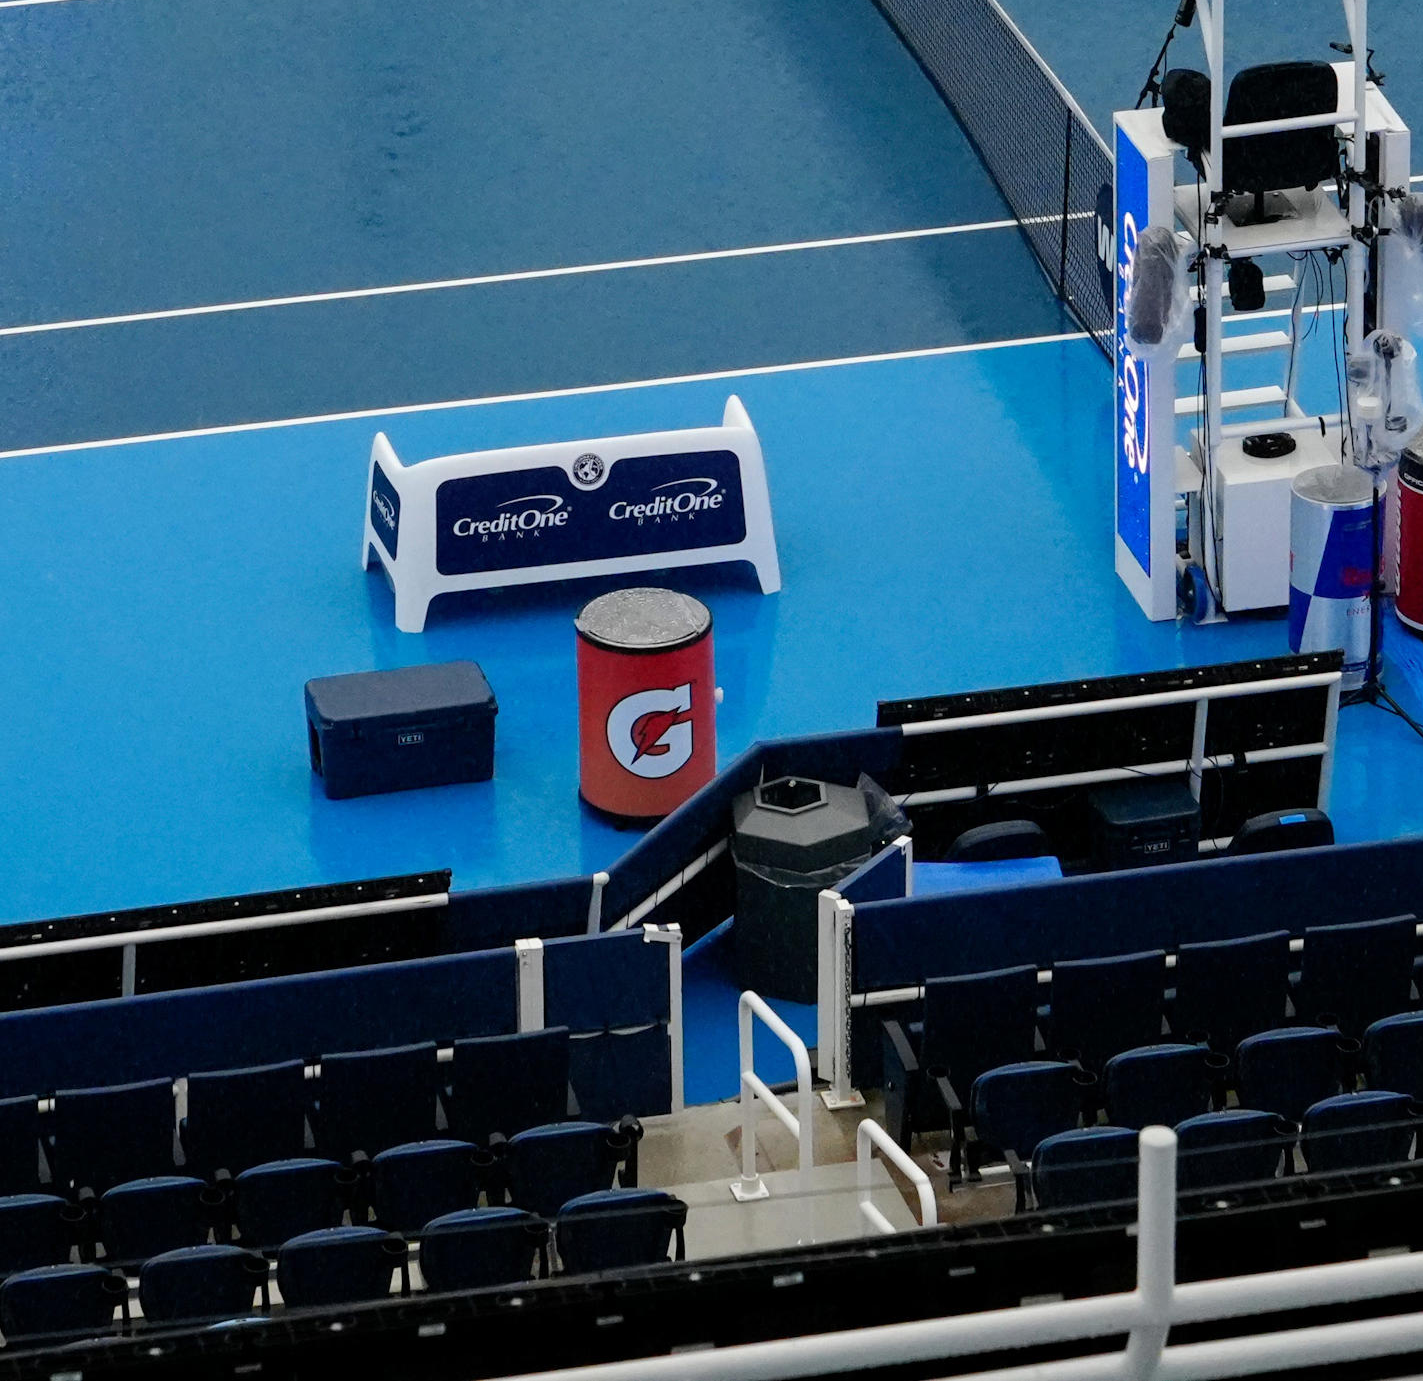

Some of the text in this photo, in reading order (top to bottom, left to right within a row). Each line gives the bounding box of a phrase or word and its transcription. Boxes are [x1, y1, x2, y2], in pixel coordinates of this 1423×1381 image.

[608, 492, 724, 520] CreditOne
[453, 509, 569, 537] CreditOne
[637, 512, 695, 526] BANK
[481, 529, 541, 543] BANK
[400, 734, 422, 743] YETI
